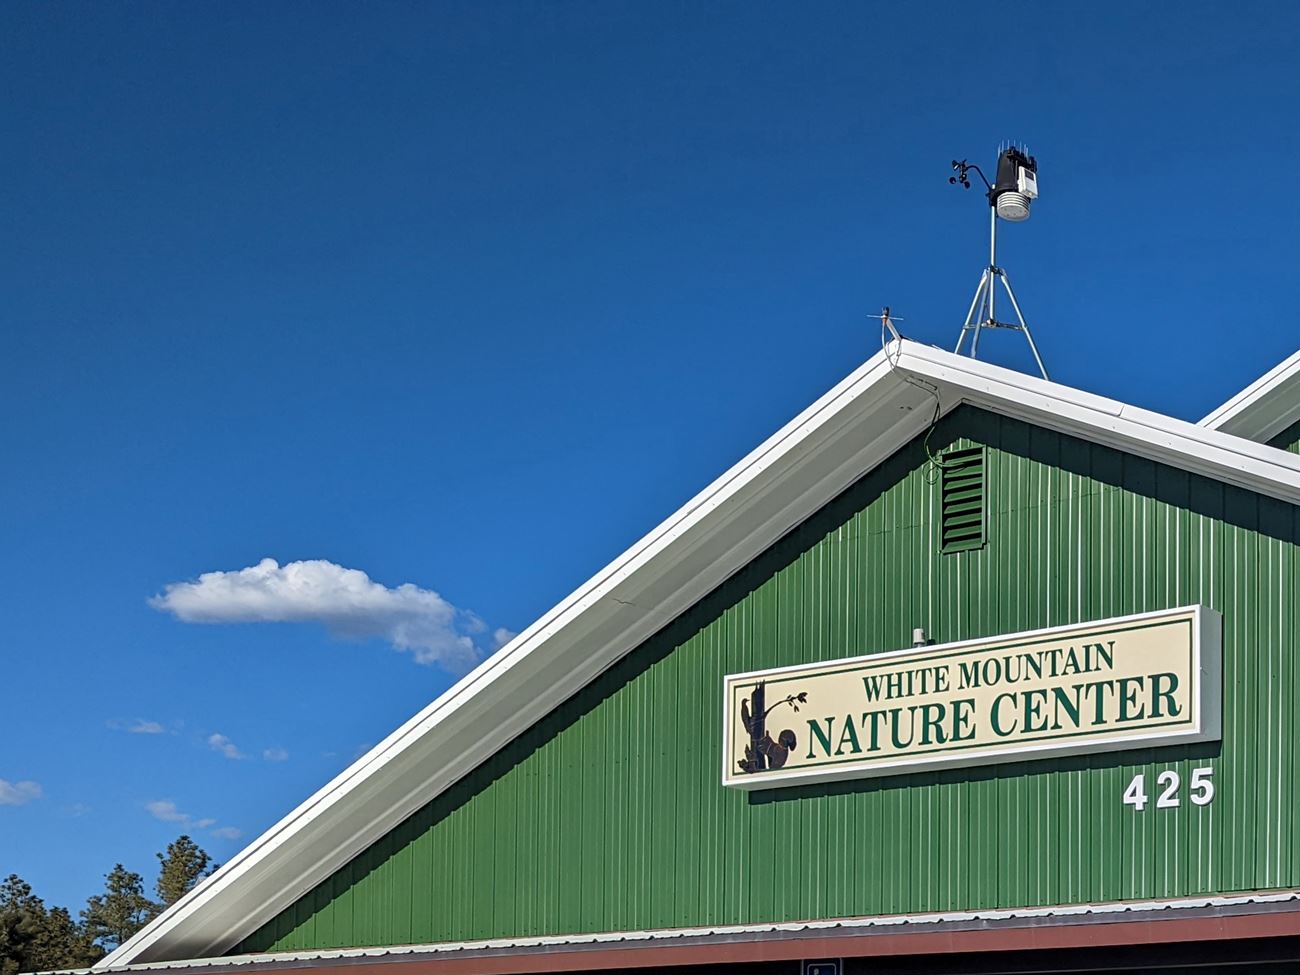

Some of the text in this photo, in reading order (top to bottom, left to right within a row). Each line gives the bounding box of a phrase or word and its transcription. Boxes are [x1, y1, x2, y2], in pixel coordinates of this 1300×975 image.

[862, 641, 1115, 703] WHITE MOUNTAIN
[806, 672, 1182, 759] NATURE CENTER
[1122, 767, 1215, 811] 425
